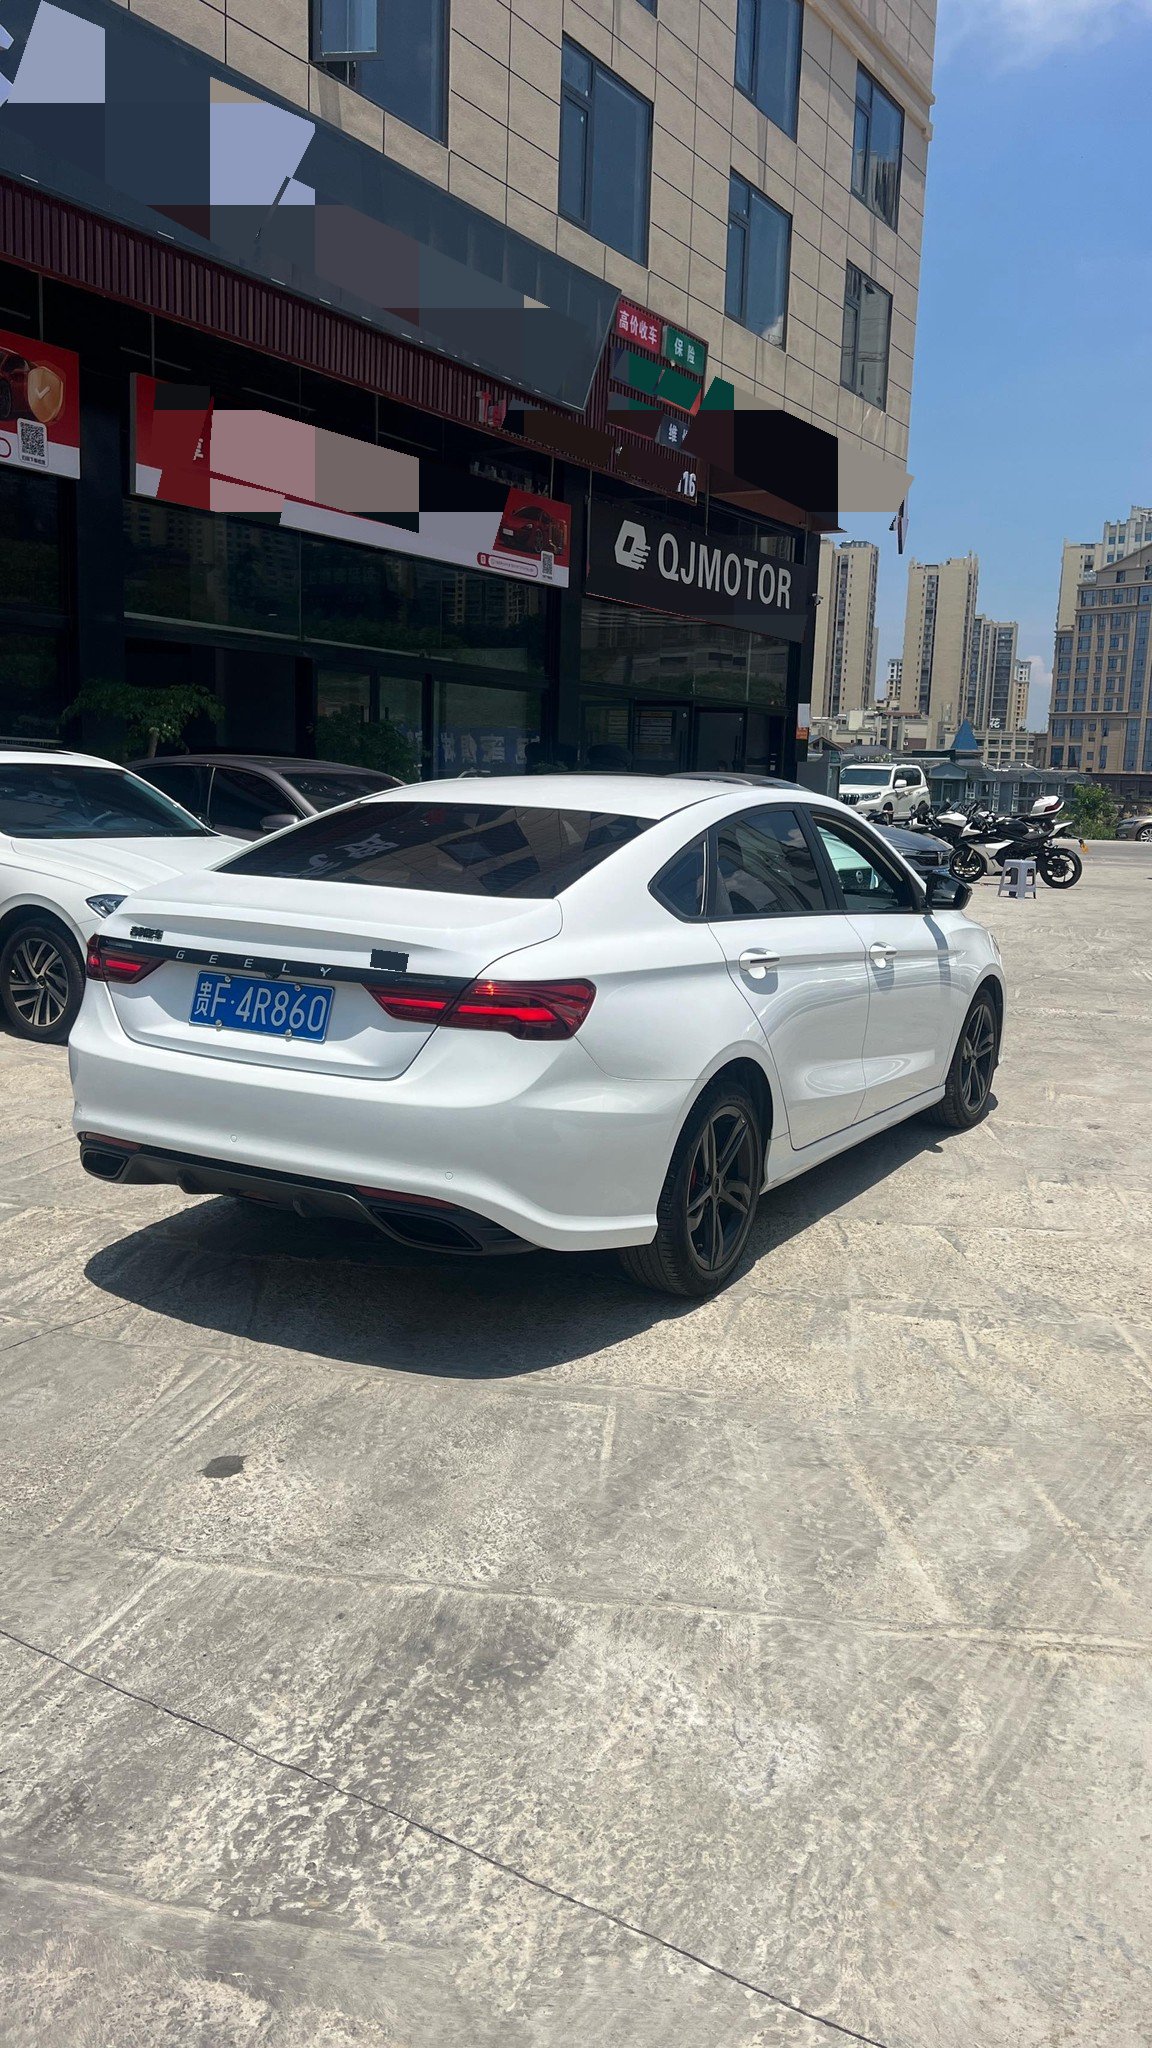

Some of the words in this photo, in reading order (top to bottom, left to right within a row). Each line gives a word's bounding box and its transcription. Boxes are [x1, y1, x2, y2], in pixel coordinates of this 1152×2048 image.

[619, 309, 658, 345] 高价收车
[674, 337, 696, 365] 保险
[657, 532, 792, 610] QJMOTOR
[175, 950, 332, 977] GEELY
